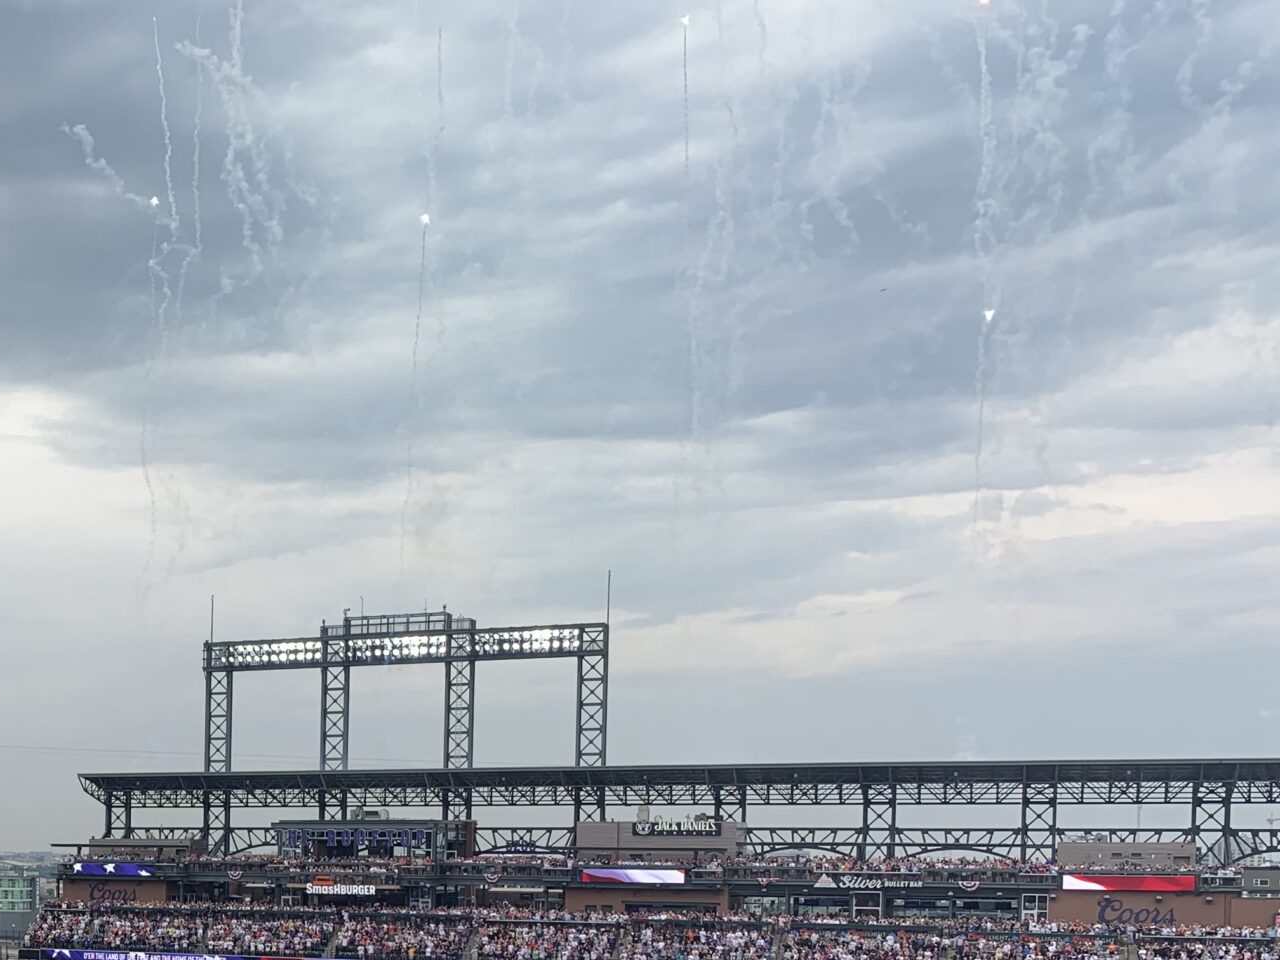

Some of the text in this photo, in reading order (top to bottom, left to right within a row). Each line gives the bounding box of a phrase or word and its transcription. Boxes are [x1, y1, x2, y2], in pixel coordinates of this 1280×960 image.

[654, 820, 678, 831] JACK
[275, 829, 427, 847] THE ROOFTOP
[839, 875, 883, 888] Silver
[89, 880, 137, 904] Coors
[1098, 900, 1176, 925] Coors
[106, 953, 119, 960] LAND
